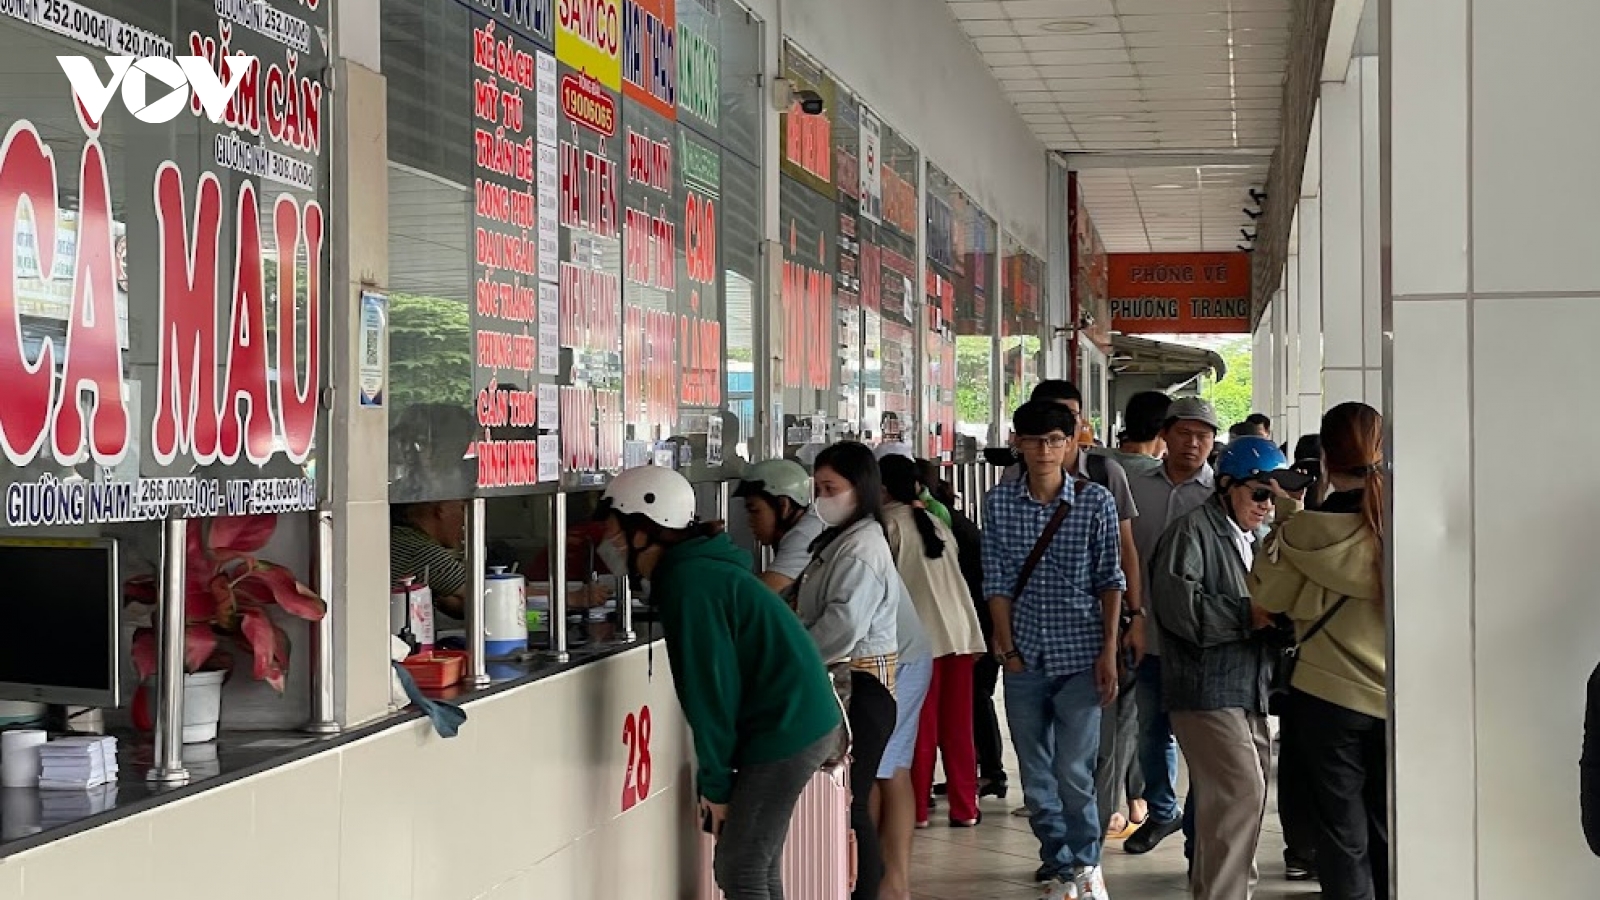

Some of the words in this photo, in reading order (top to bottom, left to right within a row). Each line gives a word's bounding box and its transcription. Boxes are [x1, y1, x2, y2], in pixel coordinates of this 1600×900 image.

[473, 19, 495, 73] KẾ
[497, 35, 534, 90] SÁCH
[557, 0, 619, 60] SAMCO
[265, 48, 322, 155] CĂN
[474, 76, 498, 123] MỸ
[501, 87, 523, 132] TÚ
[563, 85, 613, 131] 19006065
[475, 178, 509, 224] LONG
[510, 184, 535, 230] PHÚ
[560, 120, 582, 228] HÀ
[584, 135, 621, 240] TIÊN
[626, 196, 651, 287] PHÚ
[651, 203, 677, 293] TÂN
[686, 191, 716, 285] CAO
[153, 160, 324, 466] MAU
[476, 267, 498, 318] SÓC
[1110, 295, 1179, 320] PHƯƠNG
[1189, 297, 1247, 320] TRANG
[477, 376, 509, 427] CẦN
[507, 438, 537, 486] MINH
[6, 471, 85, 525] GIƯỜNG
[621, 705, 651, 812] 28
